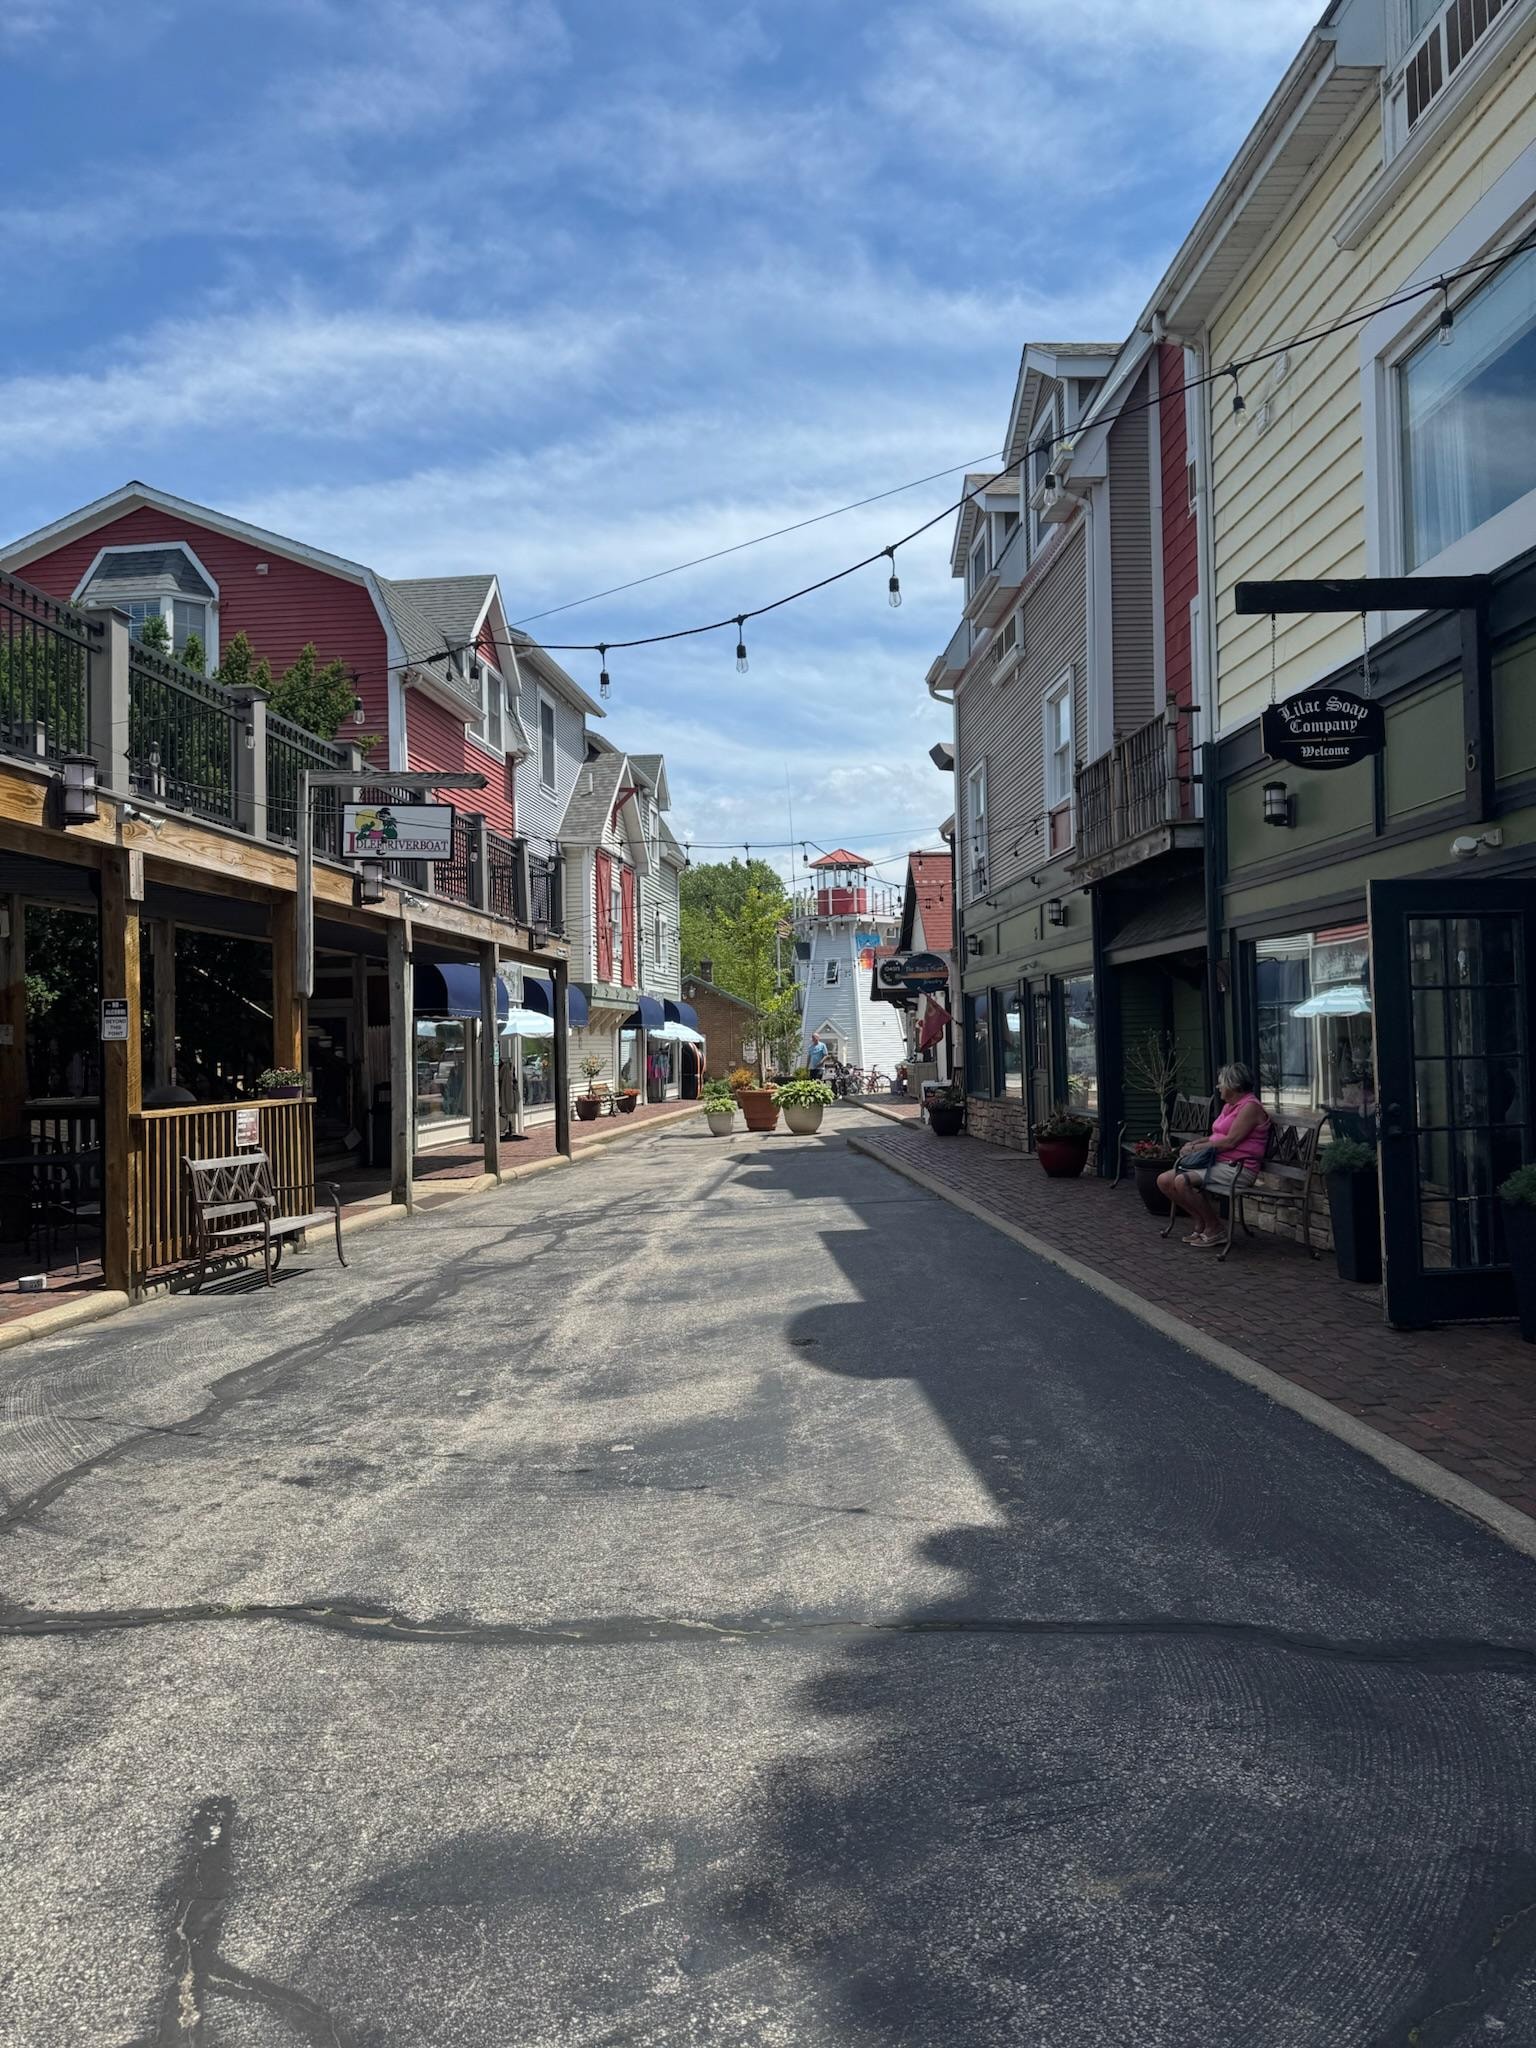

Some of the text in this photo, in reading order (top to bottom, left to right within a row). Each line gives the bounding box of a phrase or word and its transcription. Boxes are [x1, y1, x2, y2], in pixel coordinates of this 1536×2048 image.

[1277, 696, 1369, 722] Lilac Soap
[1289, 719, 1358, 733] Company
[1300, 745, 1350, 758] Welcome
[387, 840, 449, 851] RIVERBOAT
